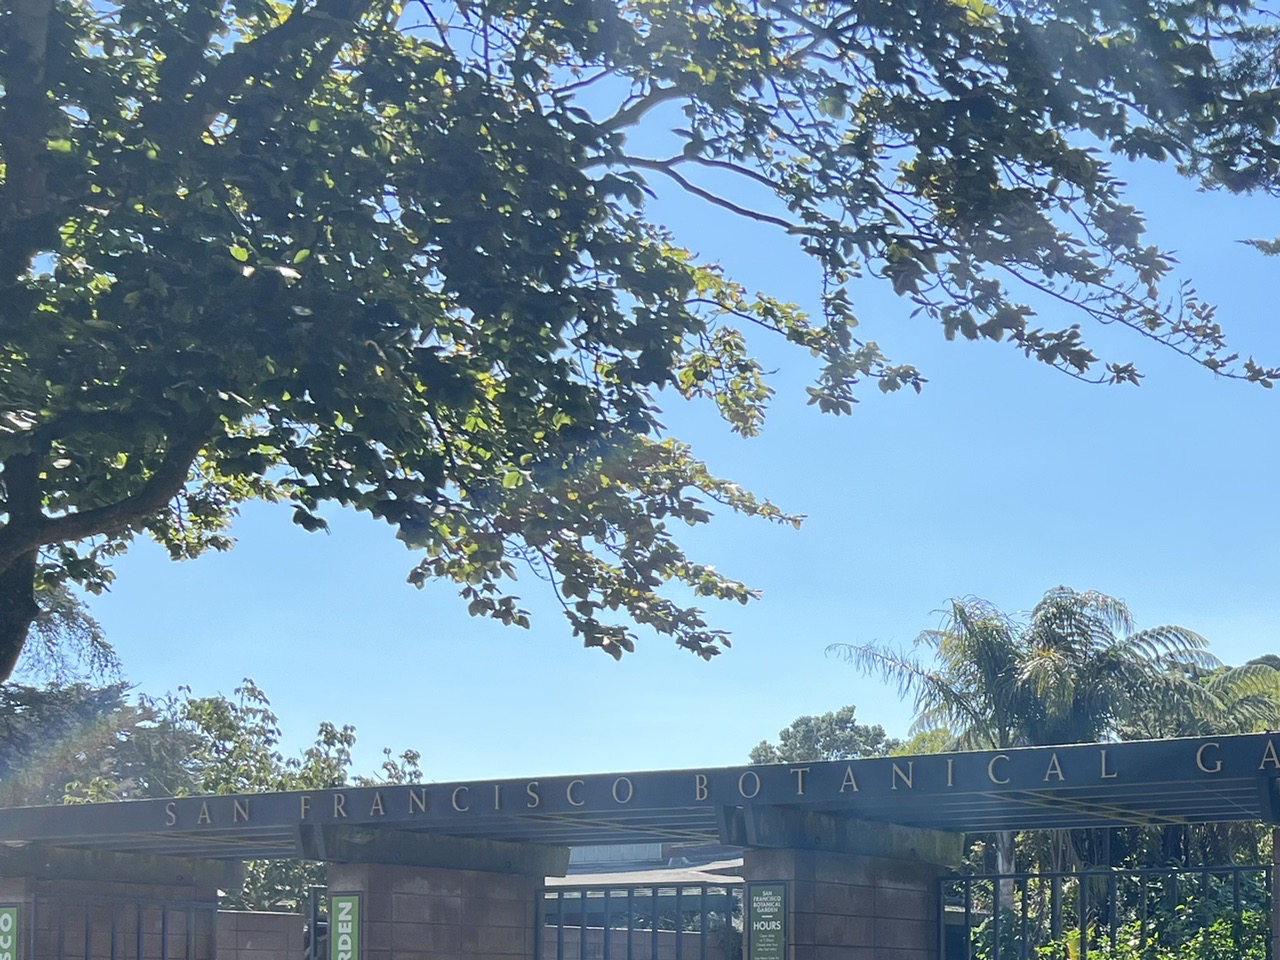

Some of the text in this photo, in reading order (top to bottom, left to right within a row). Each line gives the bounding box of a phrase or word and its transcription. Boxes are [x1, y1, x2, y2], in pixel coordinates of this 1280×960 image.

[165, 799, 250, 826] SAN
[300, 776, 634, 820] FRANCISCO
[695, 750, 1118, 801] BOTANICAL
[753, 920, 782, 930] HOURS
